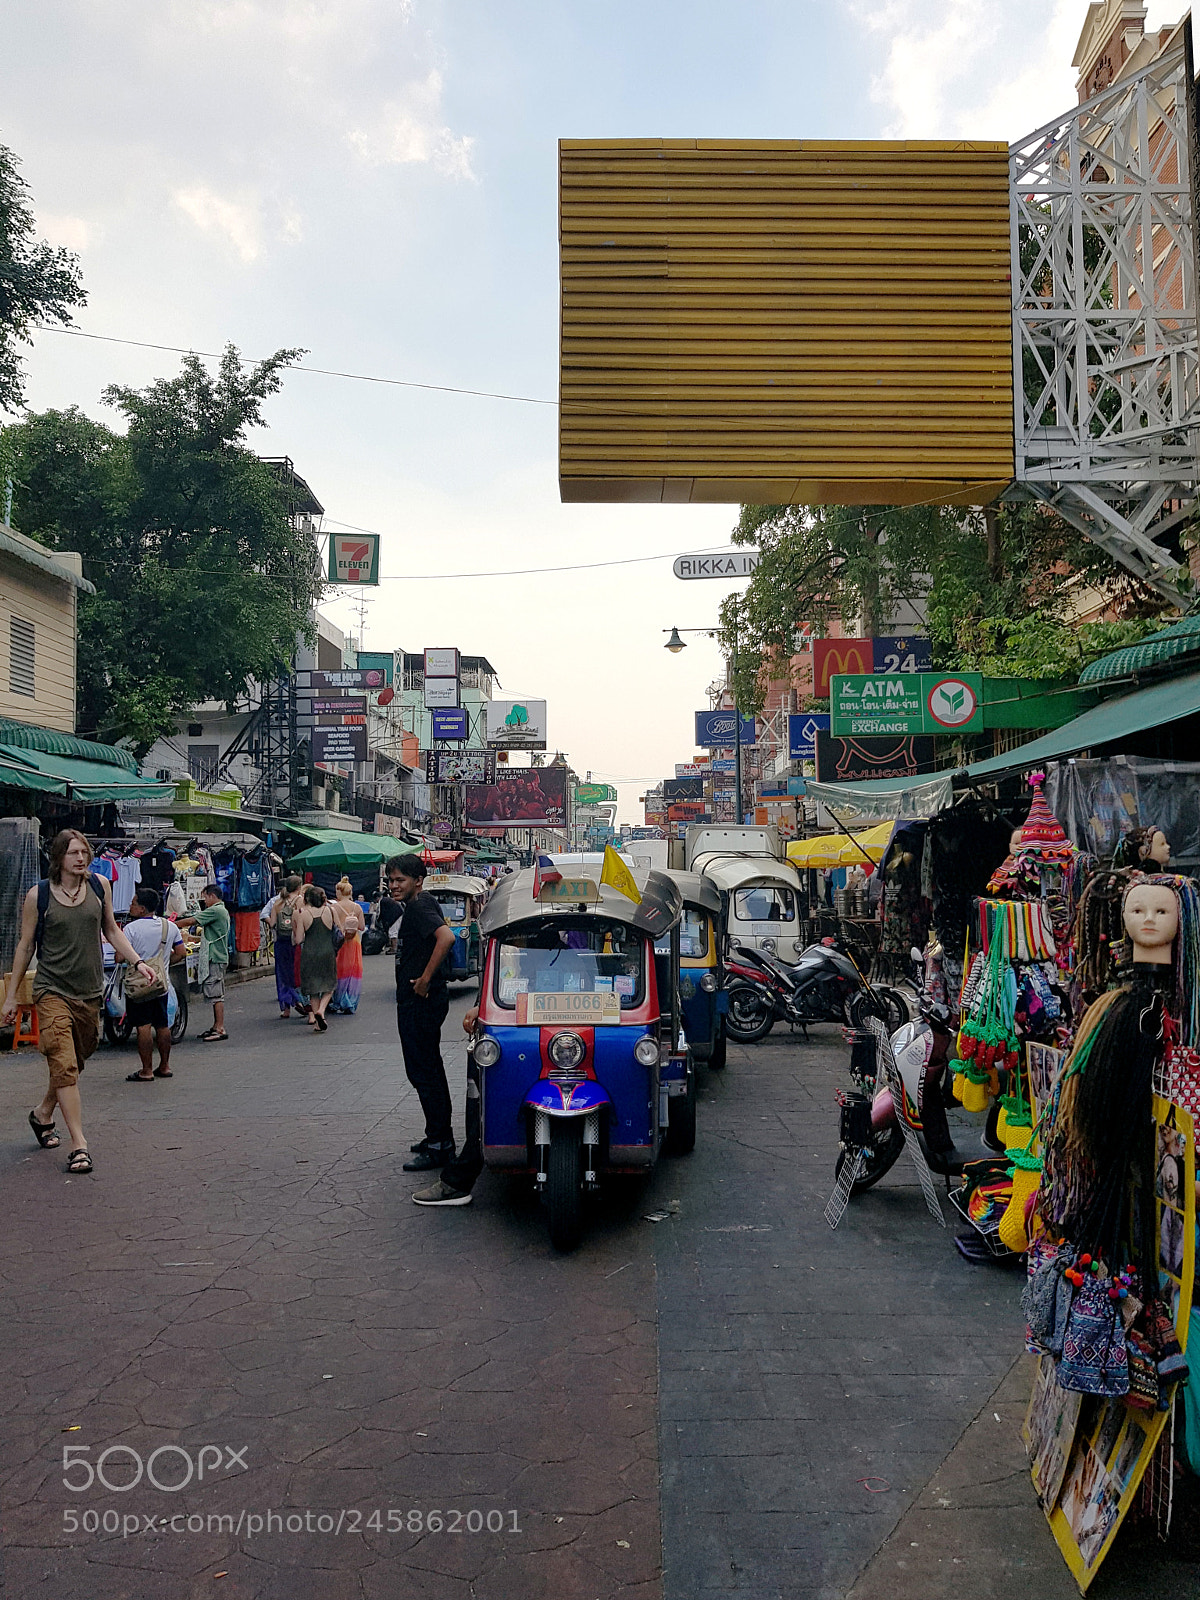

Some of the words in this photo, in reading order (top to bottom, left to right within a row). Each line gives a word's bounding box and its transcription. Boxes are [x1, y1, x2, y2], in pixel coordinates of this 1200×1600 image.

[680, 558, 737, 575] RIKKA
[884, 653, 918, 674] 24
[861, 681, 904, 698] ATM
[711, 719, 736, 734] Boot
[852, 723, 908, 733] EXCHANGE
[428, 750, 437, 782] TATTOO
[837, 768, 917, 779] MULLIGANS
[547, 881, 588, 896] TAXI
[565, 995, 601, 1010] 1066
